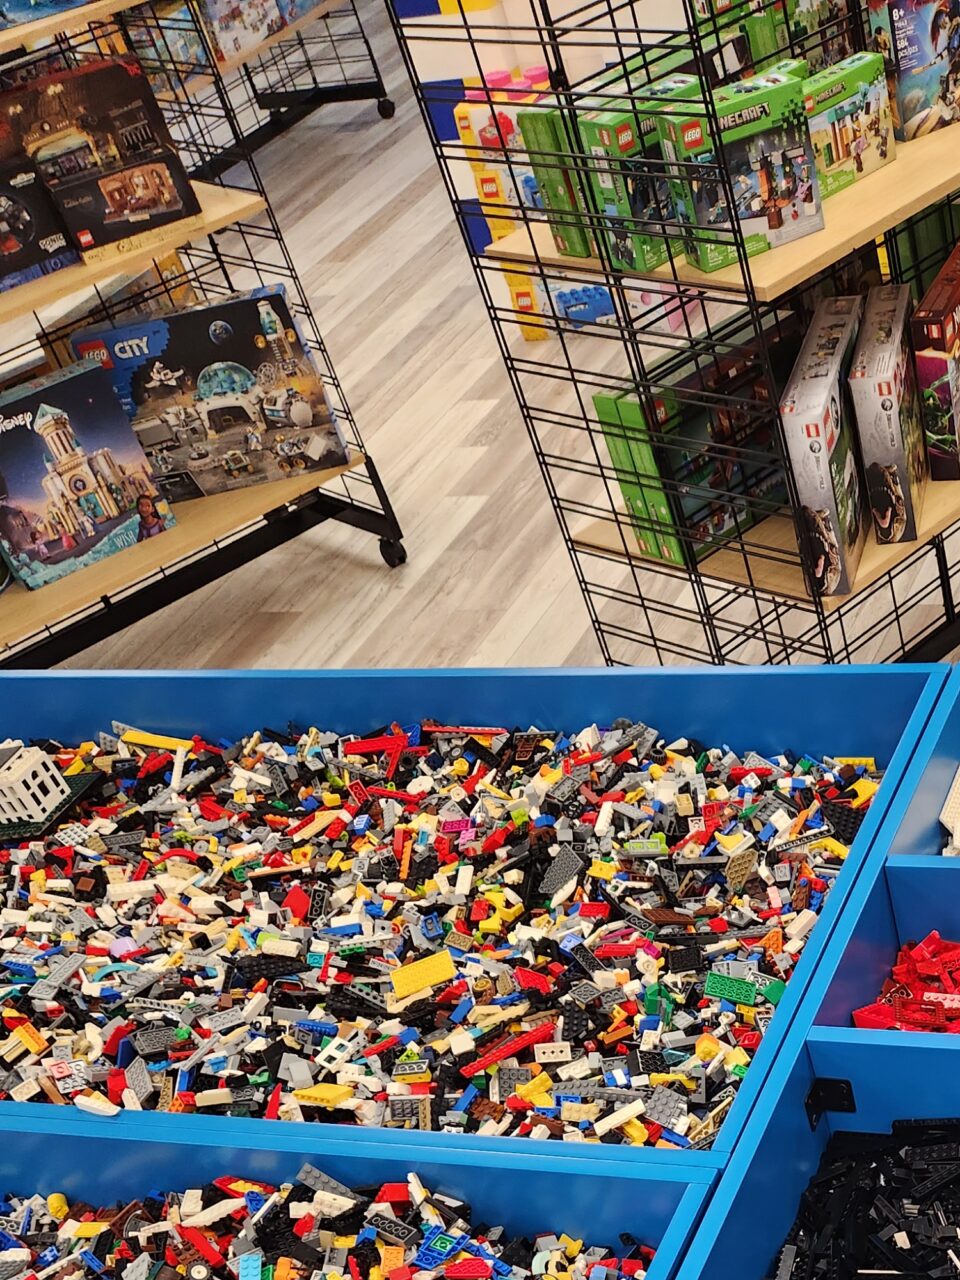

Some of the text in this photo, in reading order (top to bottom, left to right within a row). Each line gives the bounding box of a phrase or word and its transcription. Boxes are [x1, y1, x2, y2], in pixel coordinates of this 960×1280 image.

[683, 127, 702, 141] LEGO
[114, 336, 149, 359] CITY
[113, 530, 138, 548] WISH
